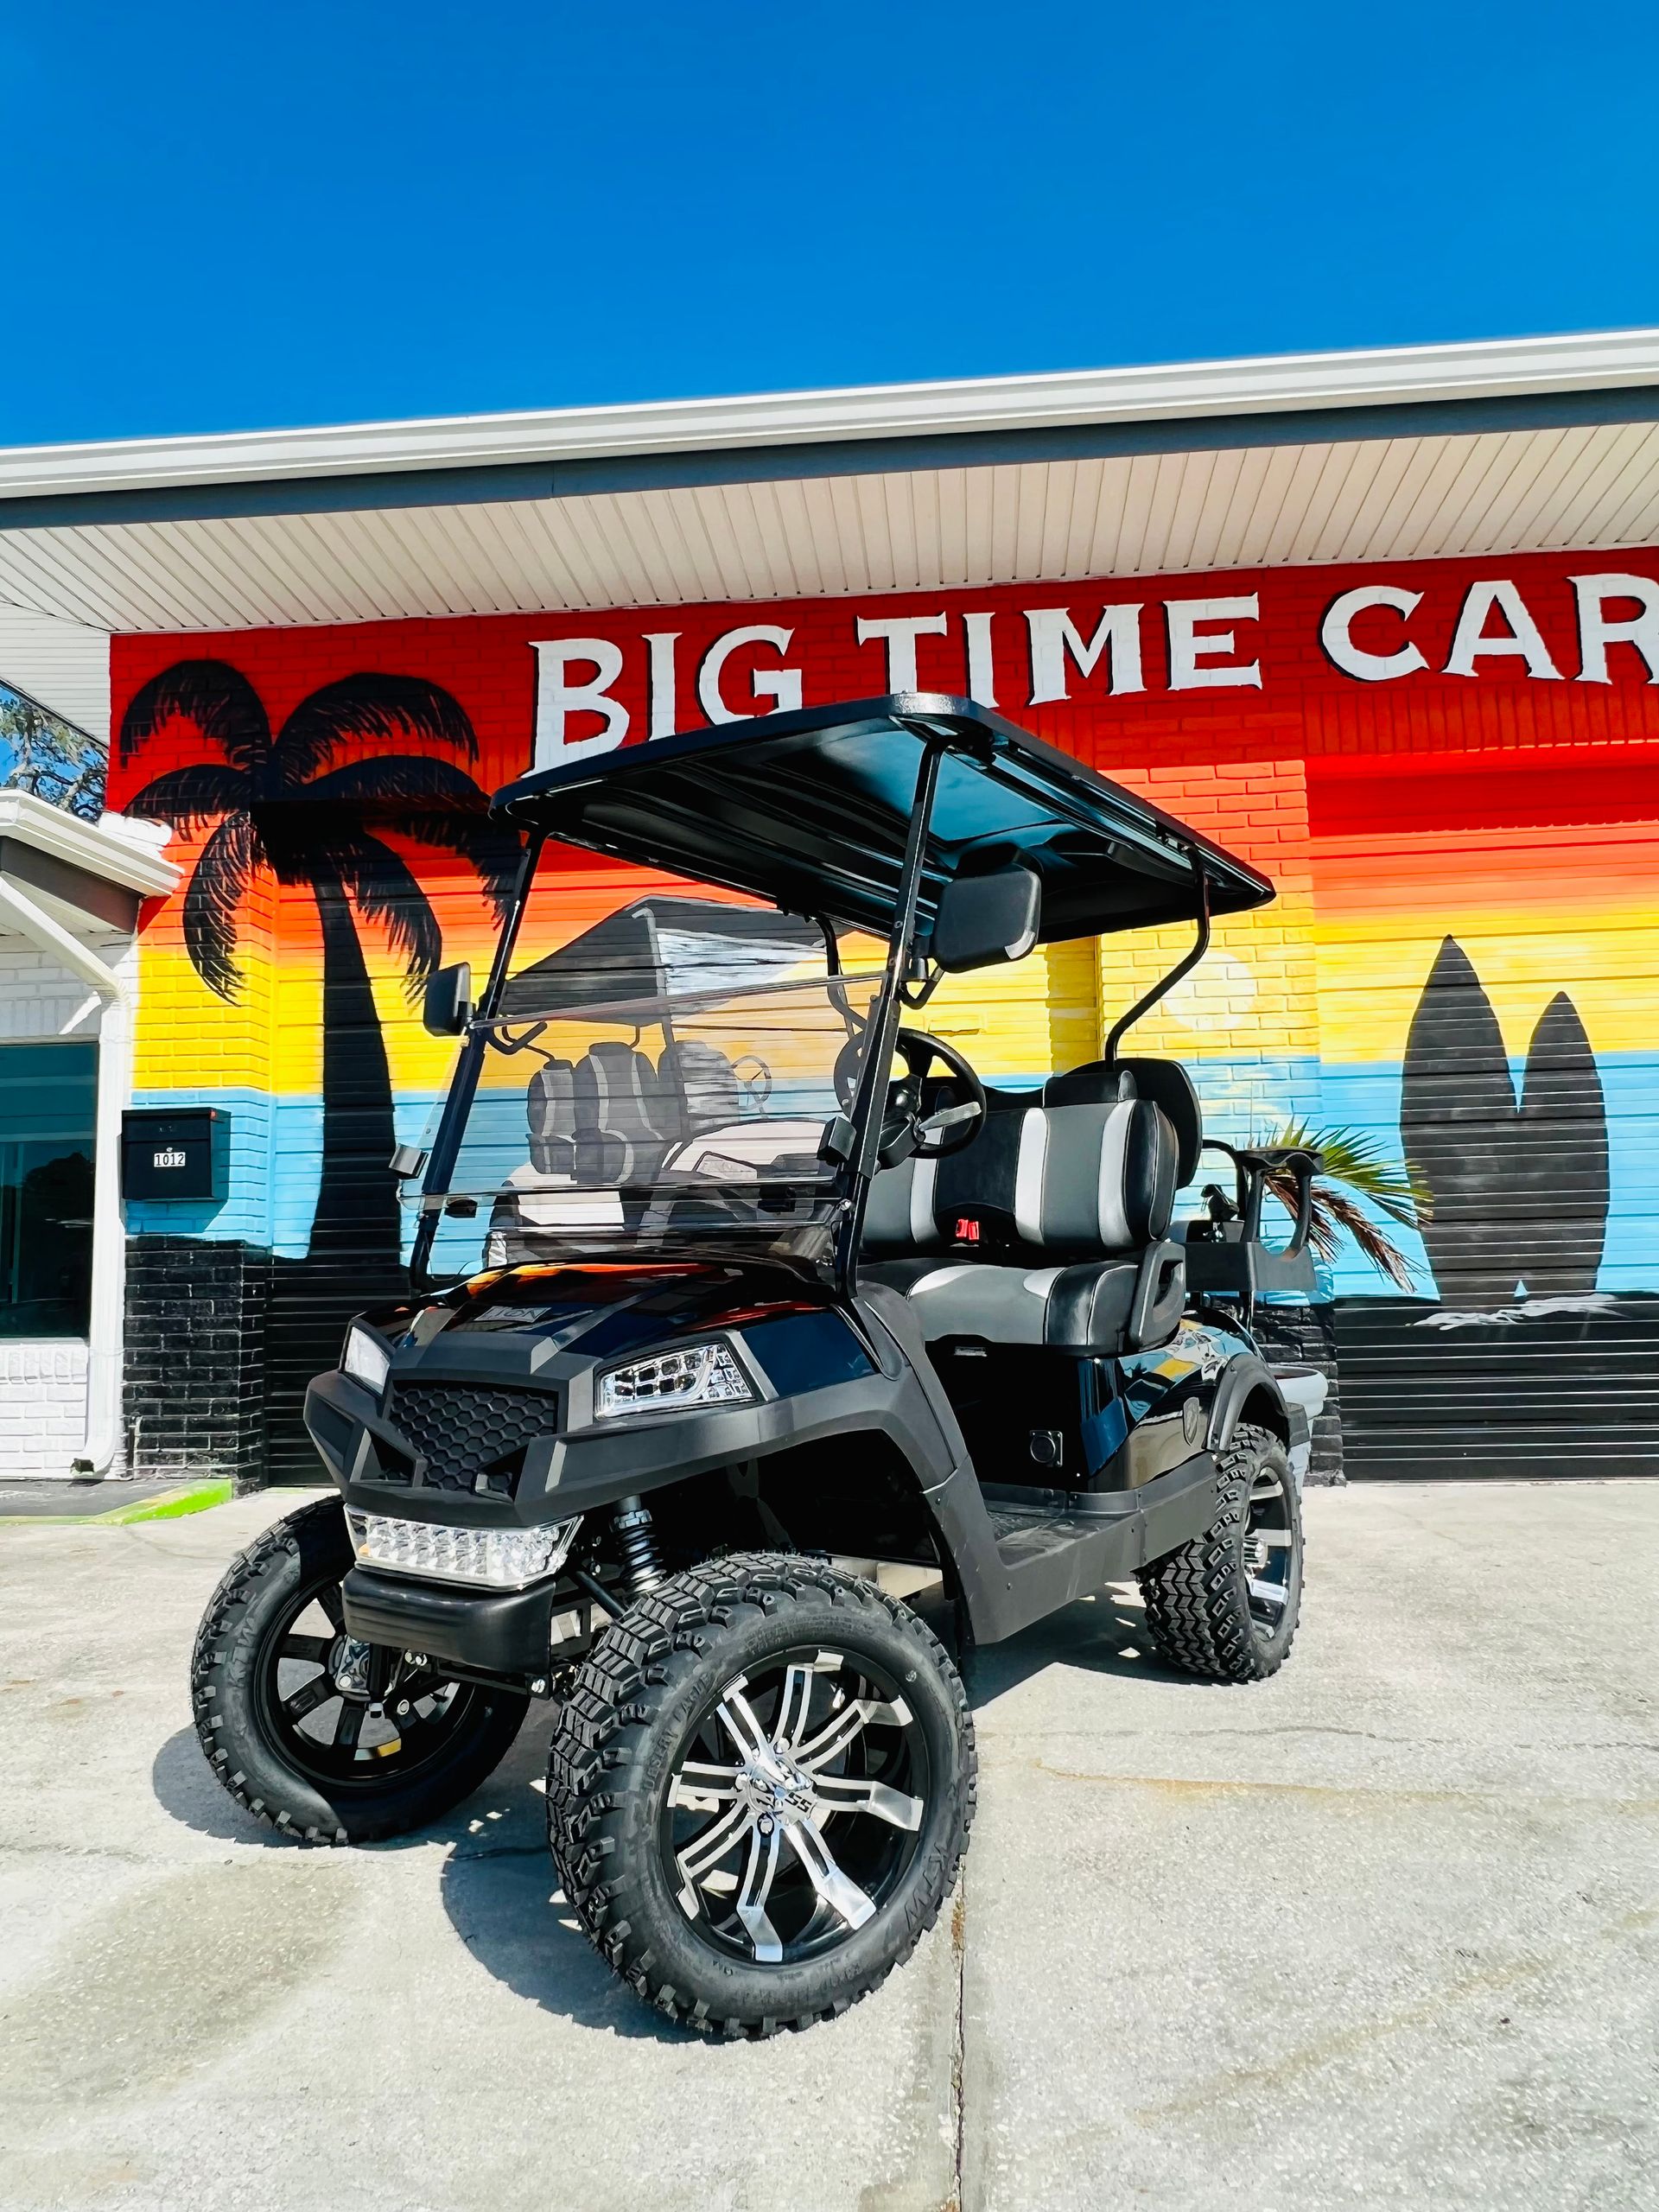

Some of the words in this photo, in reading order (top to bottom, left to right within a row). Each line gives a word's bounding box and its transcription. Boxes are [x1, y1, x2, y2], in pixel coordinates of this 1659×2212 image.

[519, 625, 802, 779] BIG
[856, 591, 1262, 709] TIME
[1322, 573, 1659, 685] CAR
[155, 1154, 184, 1166] 1012
